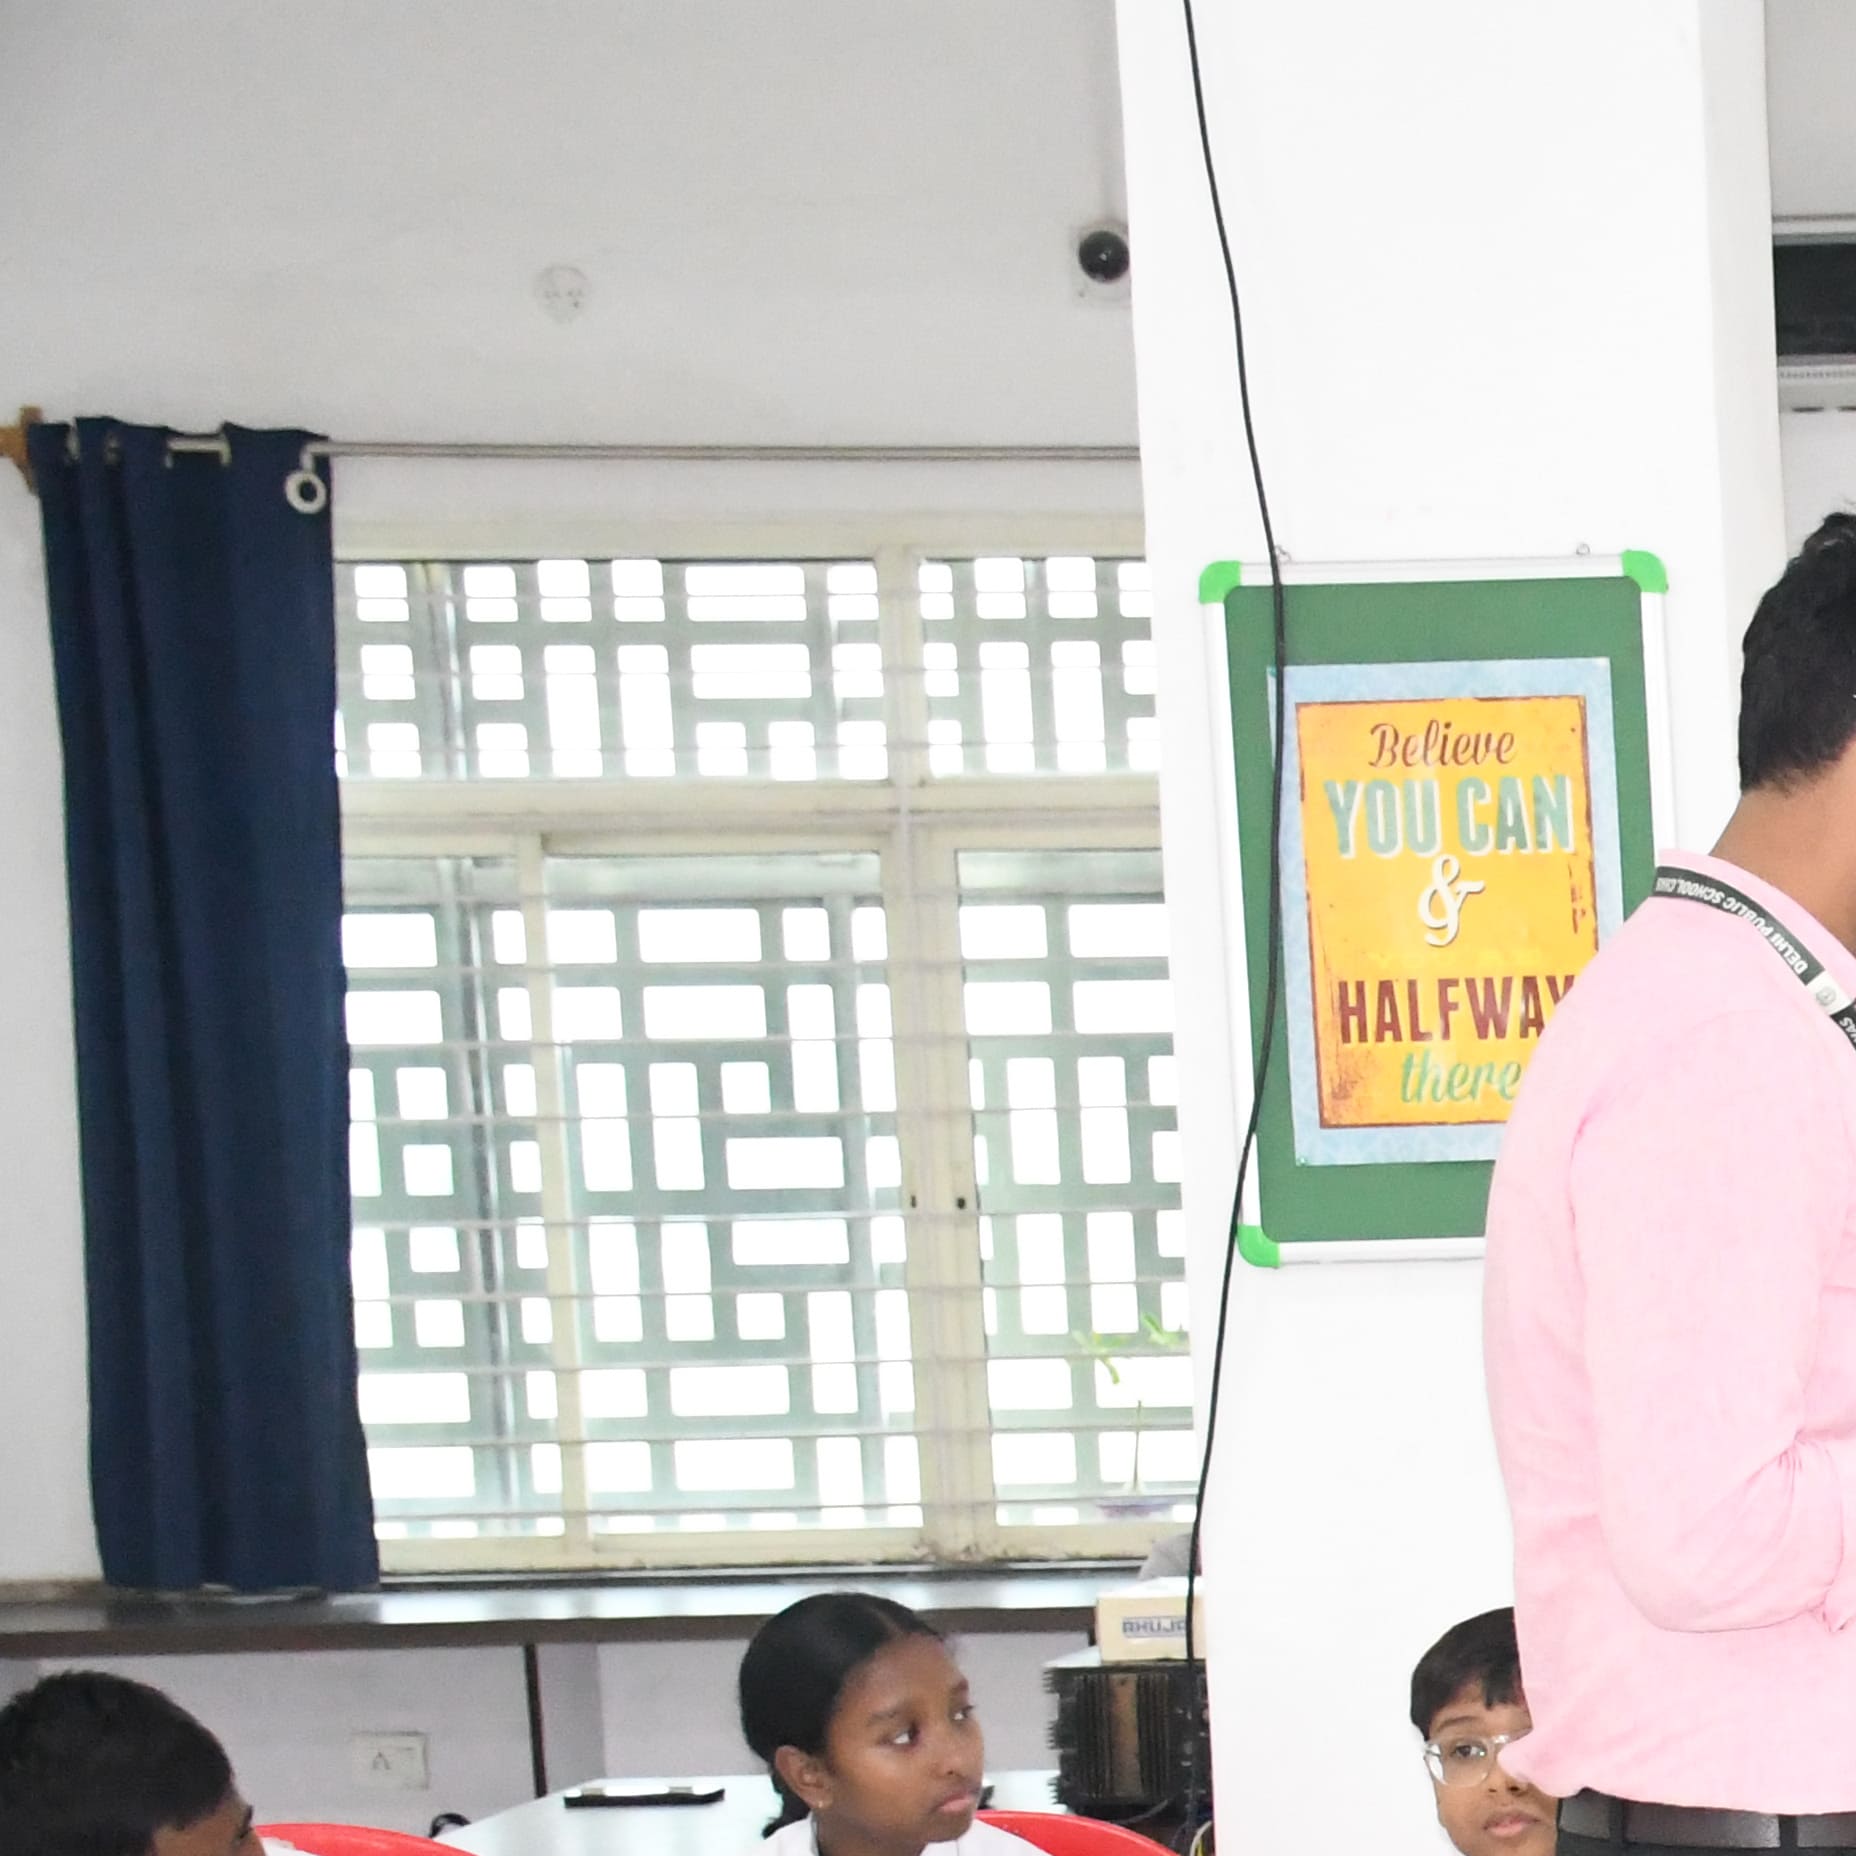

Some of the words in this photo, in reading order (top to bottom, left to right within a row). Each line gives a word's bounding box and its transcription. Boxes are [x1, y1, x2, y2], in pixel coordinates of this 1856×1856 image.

[1369, 720, 1516, 769] Believe
[1323, 777, 1441, 859] YOU
[1456, 773, 1575, 858] CAN
[1417, 854, 1485, 948] &
[1722, 896, 1774, 937] PUBLIC
[1769, 932, 1809, 975] DELHI
[1399, 1048, 1523, 1104] there
